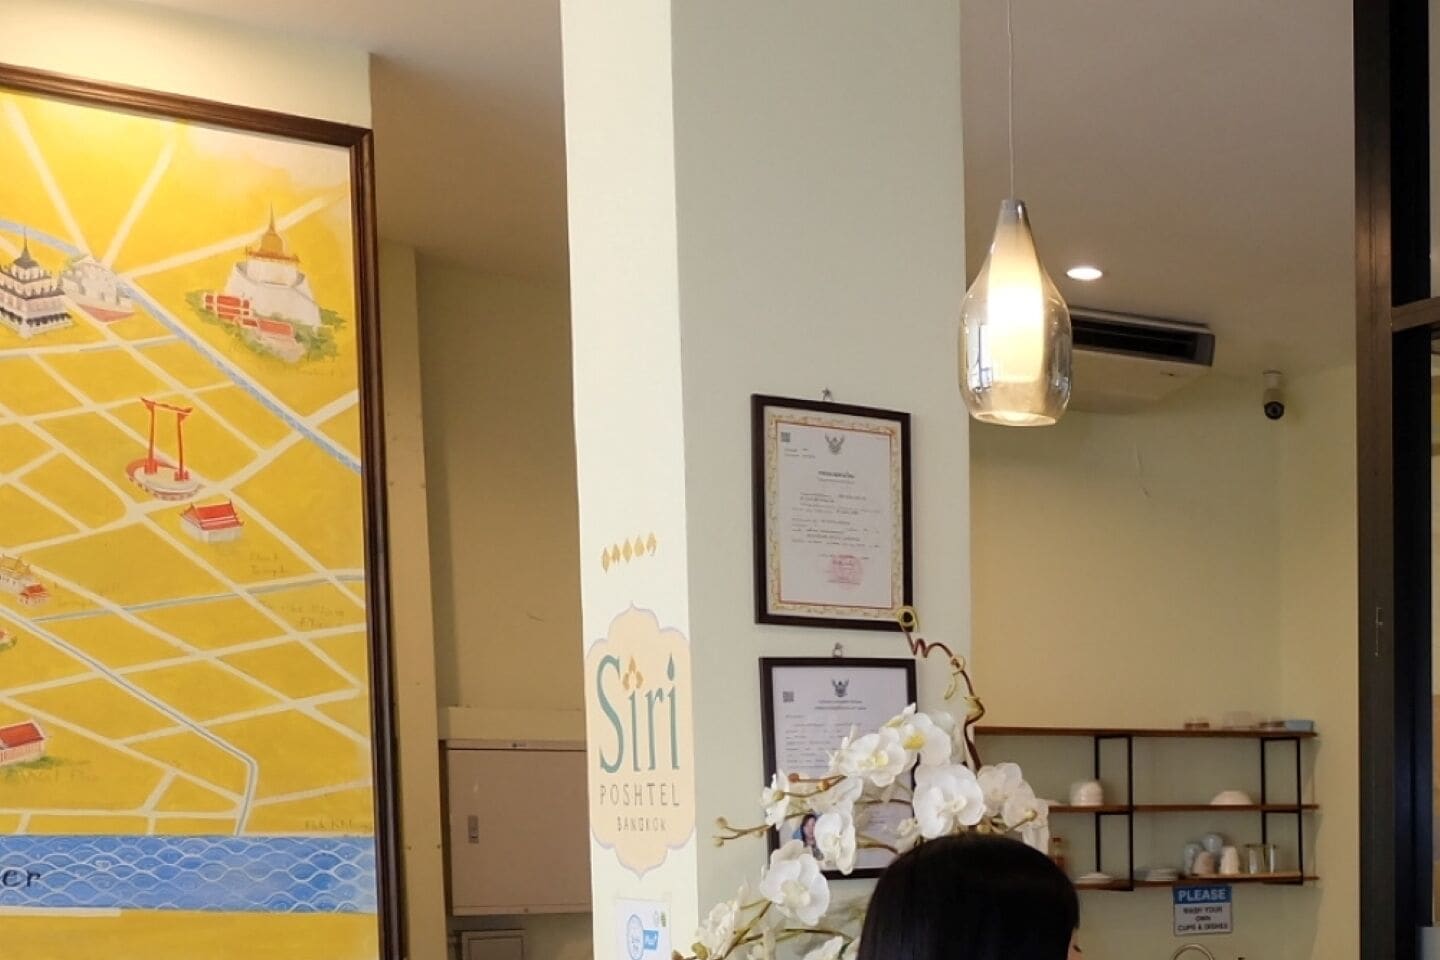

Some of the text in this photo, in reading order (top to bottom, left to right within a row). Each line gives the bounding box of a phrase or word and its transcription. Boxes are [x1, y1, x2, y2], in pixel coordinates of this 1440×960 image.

[597, 653, 680, 773] Siri
[600, 783, 680, 807] POSHTEL
[616, 816, 667, 832] BANGKOK
[1178, 888, 1227, 902] PLEASE
